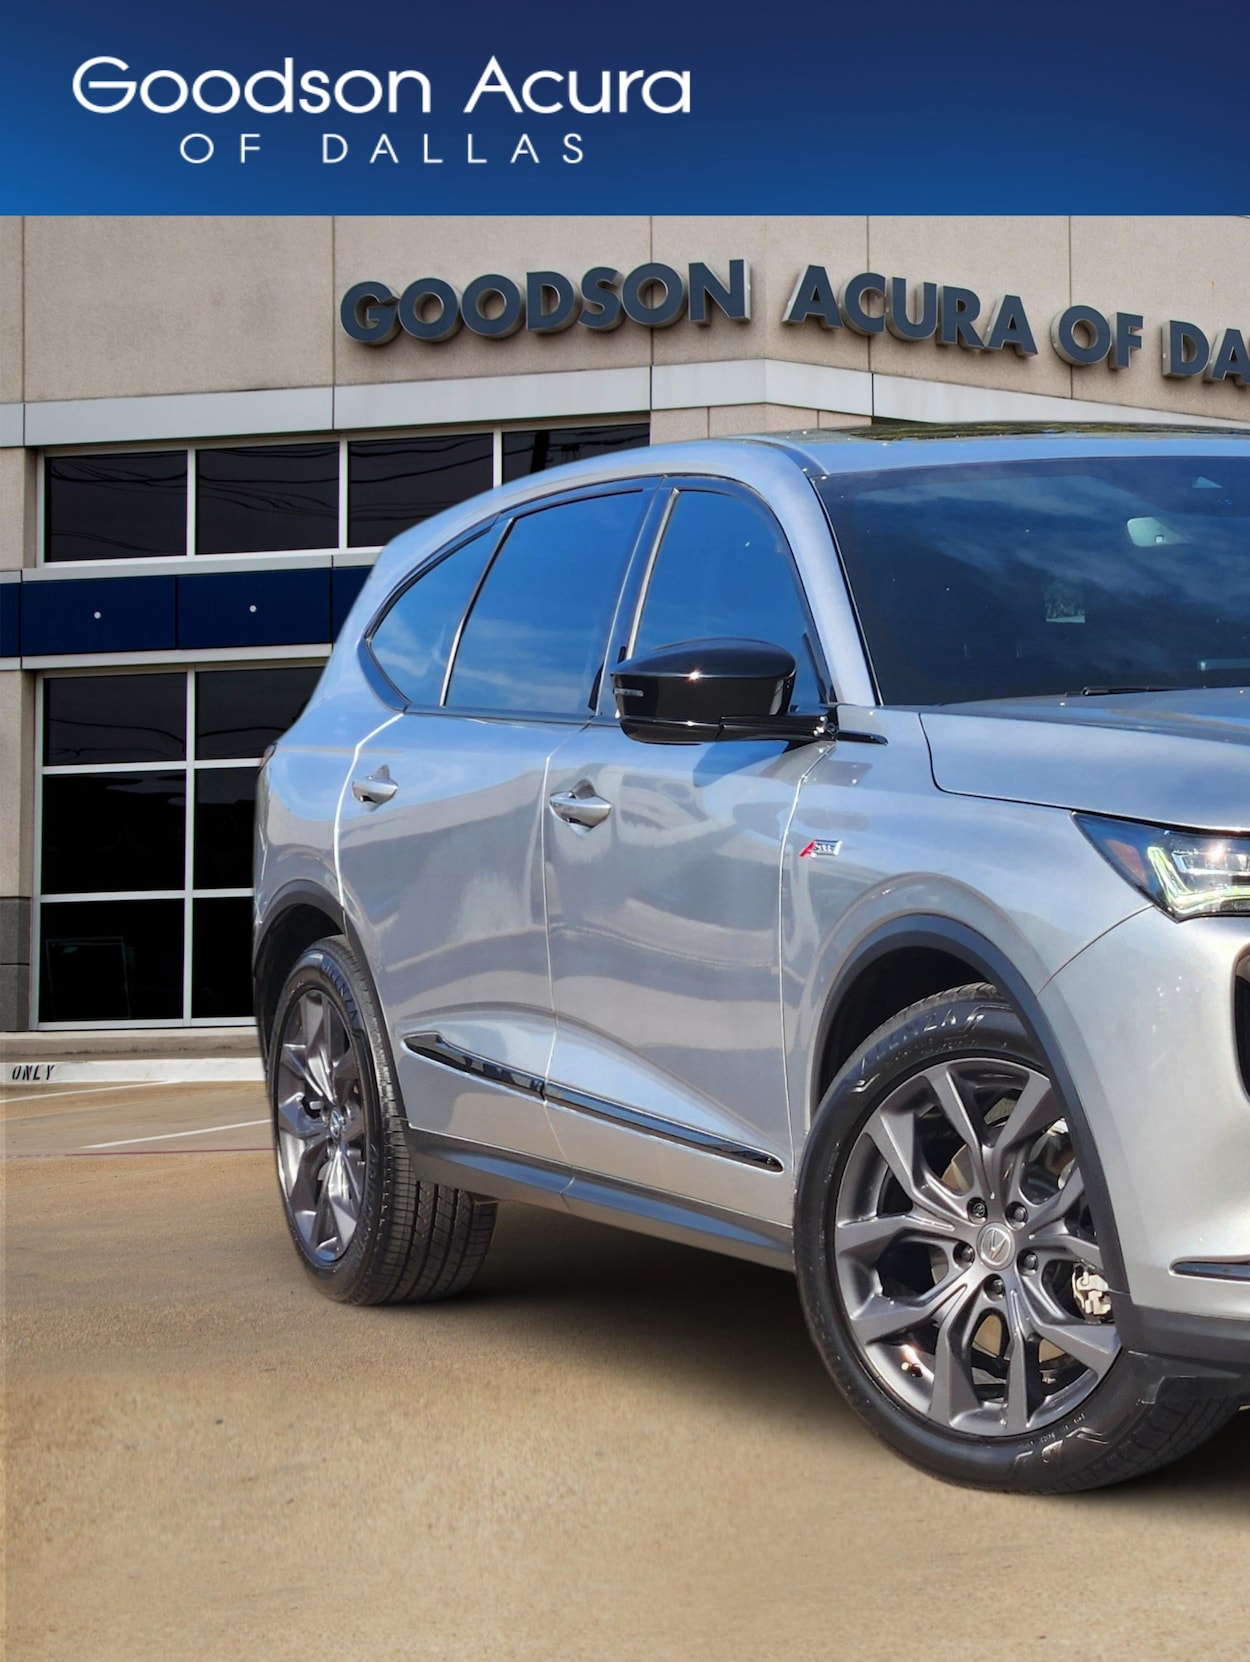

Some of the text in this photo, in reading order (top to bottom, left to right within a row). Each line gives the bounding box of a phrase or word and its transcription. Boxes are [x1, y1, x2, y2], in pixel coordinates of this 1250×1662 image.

[340, 260, 752, 345] GOODSON
[782, 264, 1038, 355] ACURA
[1050, 305, 1144, 369] OF
[11, 1064, 56, 1081] ONLY
